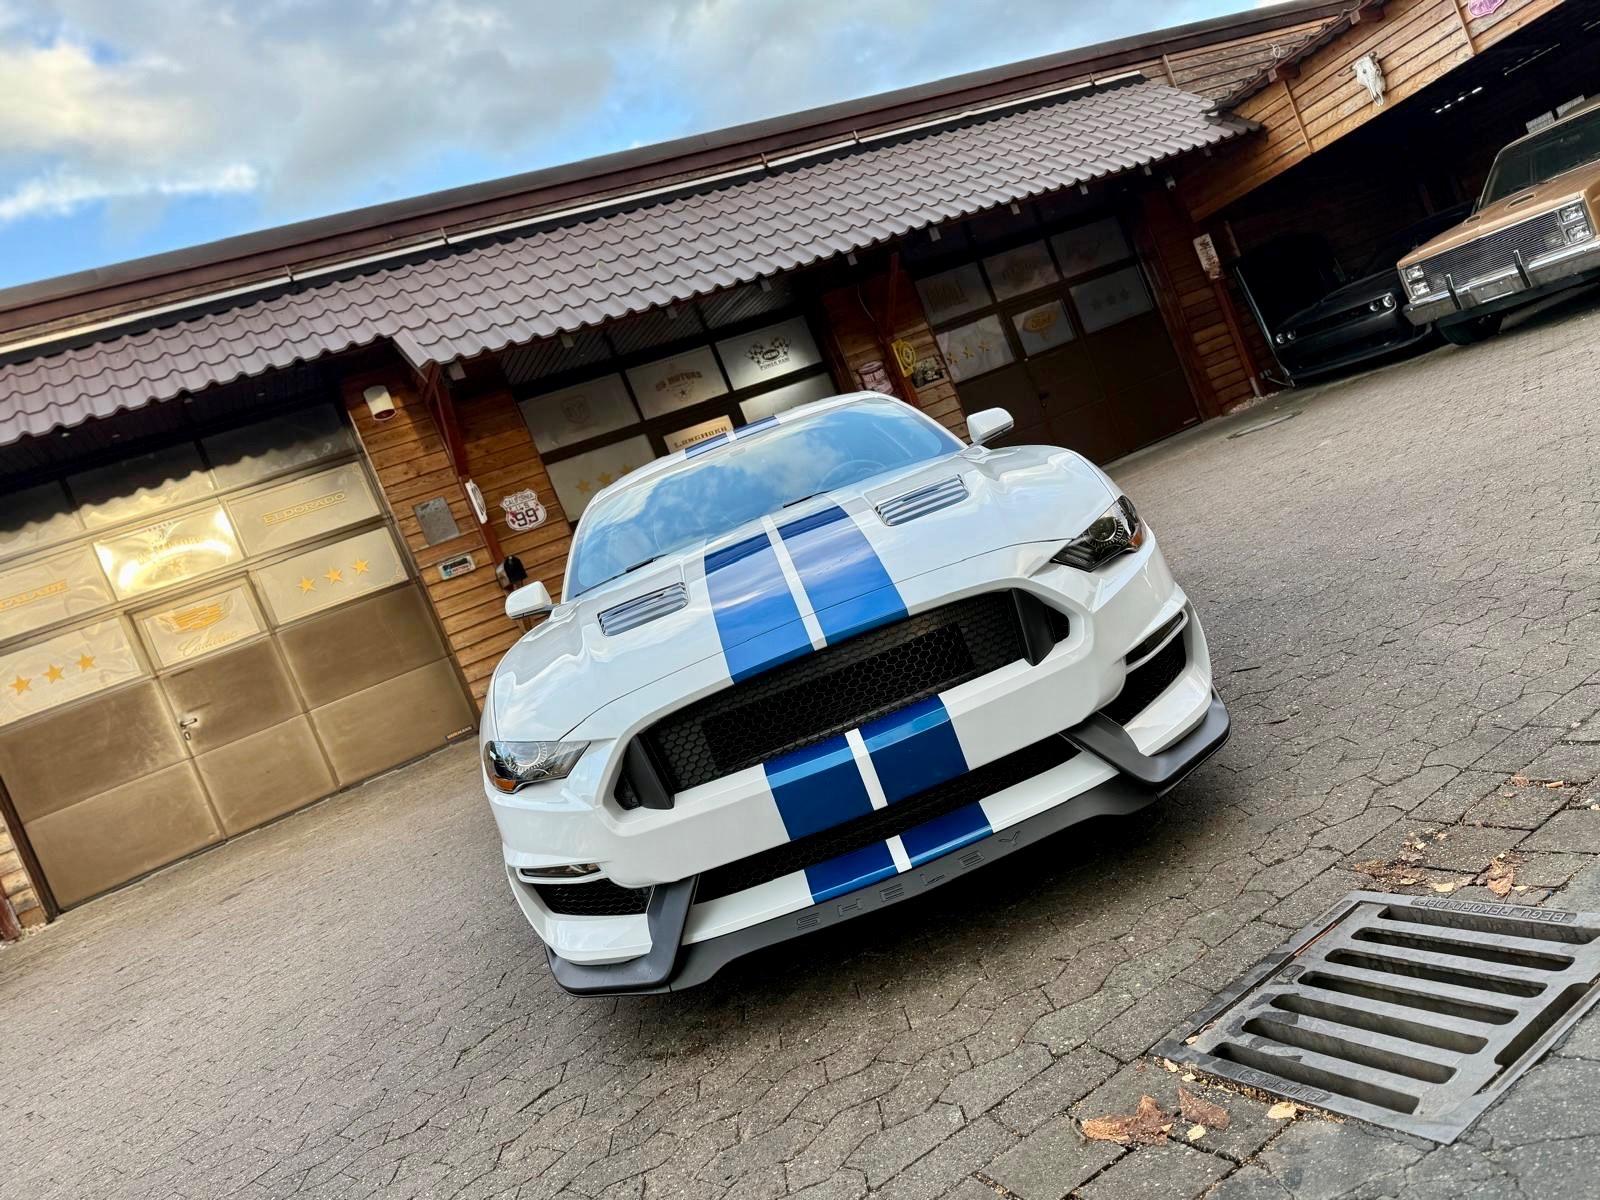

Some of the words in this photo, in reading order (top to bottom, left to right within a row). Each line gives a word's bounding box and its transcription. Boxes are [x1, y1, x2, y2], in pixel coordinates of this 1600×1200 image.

[263, 492, 346, 524] ELDORADO
[504, 492, 534, 506] CALIFORNIA
[515, 508, 539, 527] 99
[796, 830, 1021, 930] SHELBY
[1520, 909, 1567, 922] BEGU
